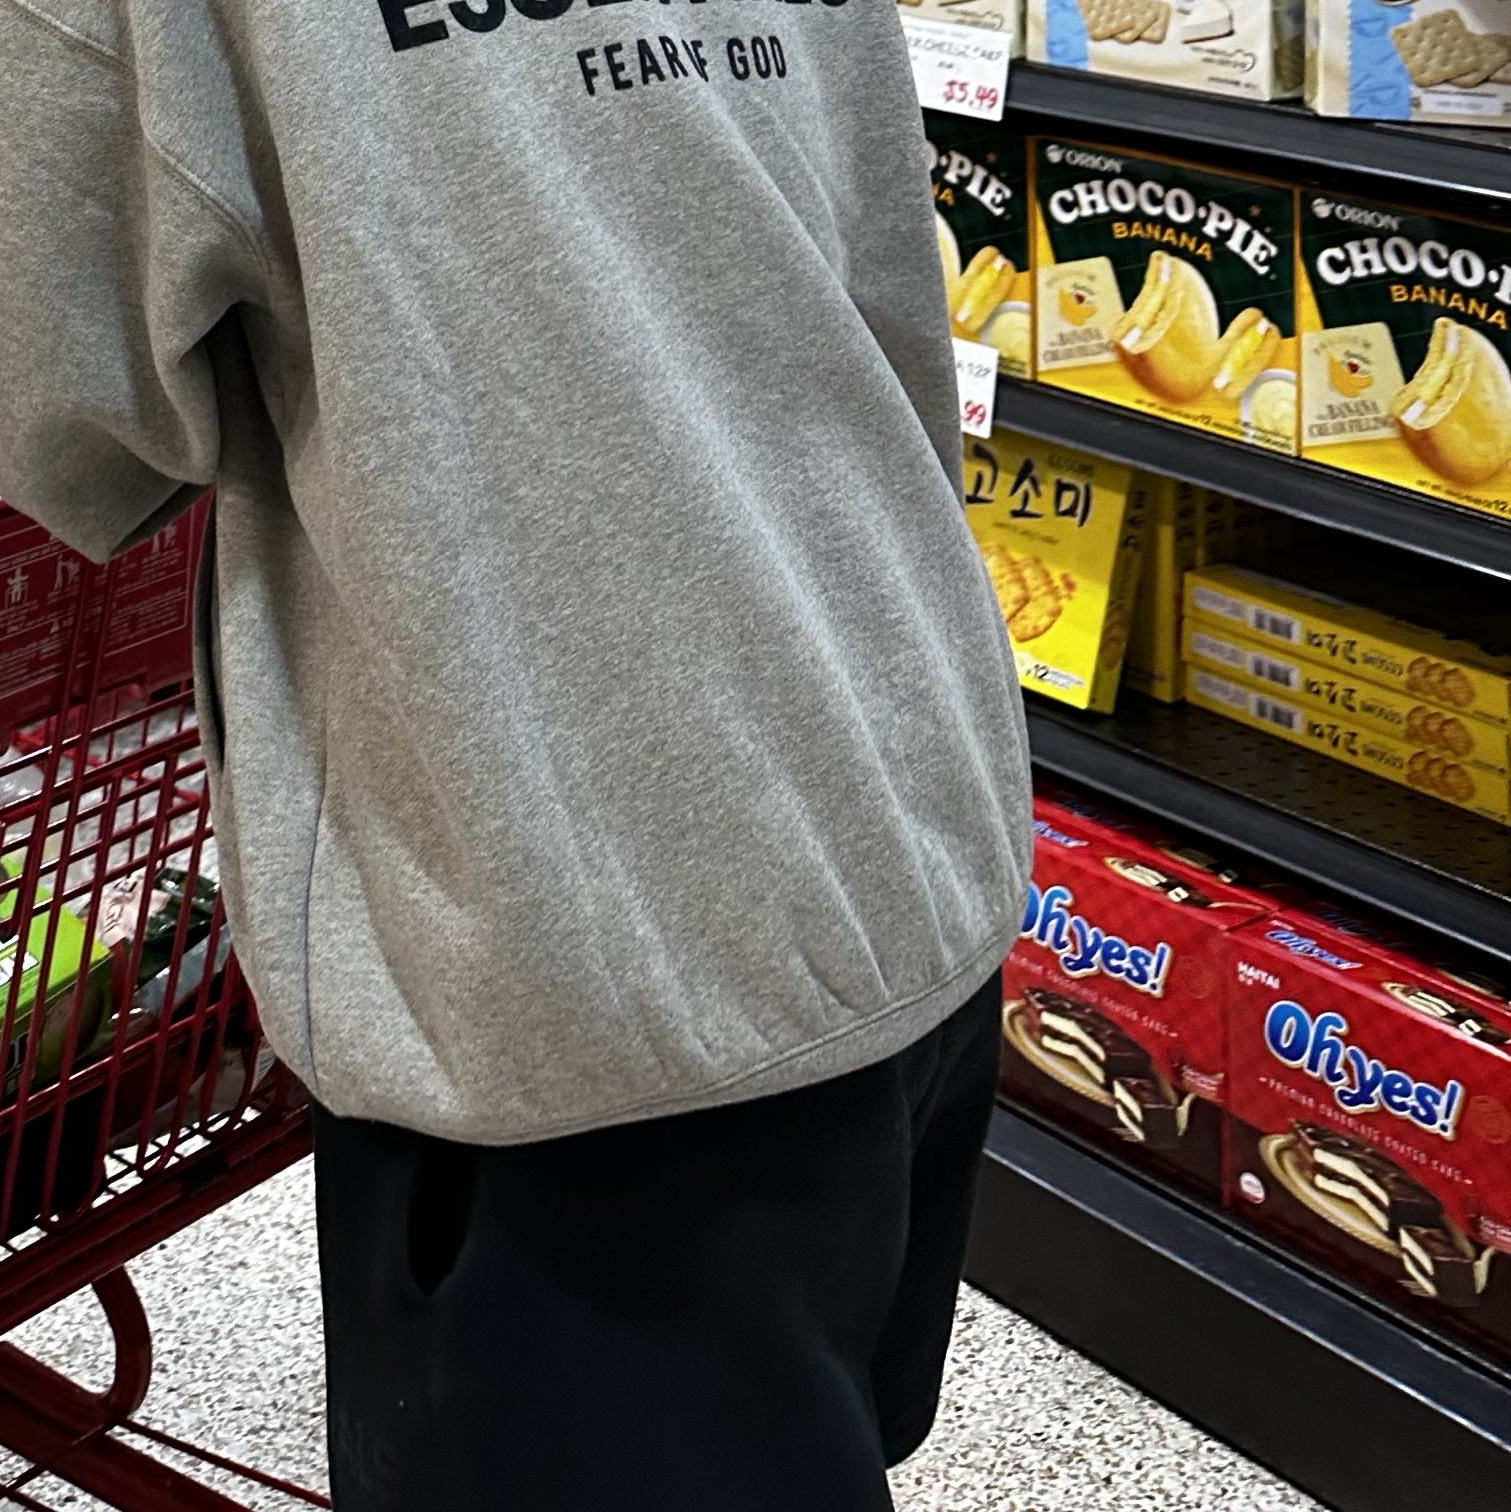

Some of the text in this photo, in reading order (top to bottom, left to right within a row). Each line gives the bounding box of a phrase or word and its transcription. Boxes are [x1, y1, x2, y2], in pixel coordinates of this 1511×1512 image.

[576, 35, 689, 96] FEAR
[726, 35, 787, 80] GOD
[1065, 150, 1124, 174] ORION
[1334, 204, 1400, 232] ORION
[1111, 221, 1215, 262] BANANA
[1389, 284, 1509, 331] BANANA
[966, 442, 1095, 529] 고소미
